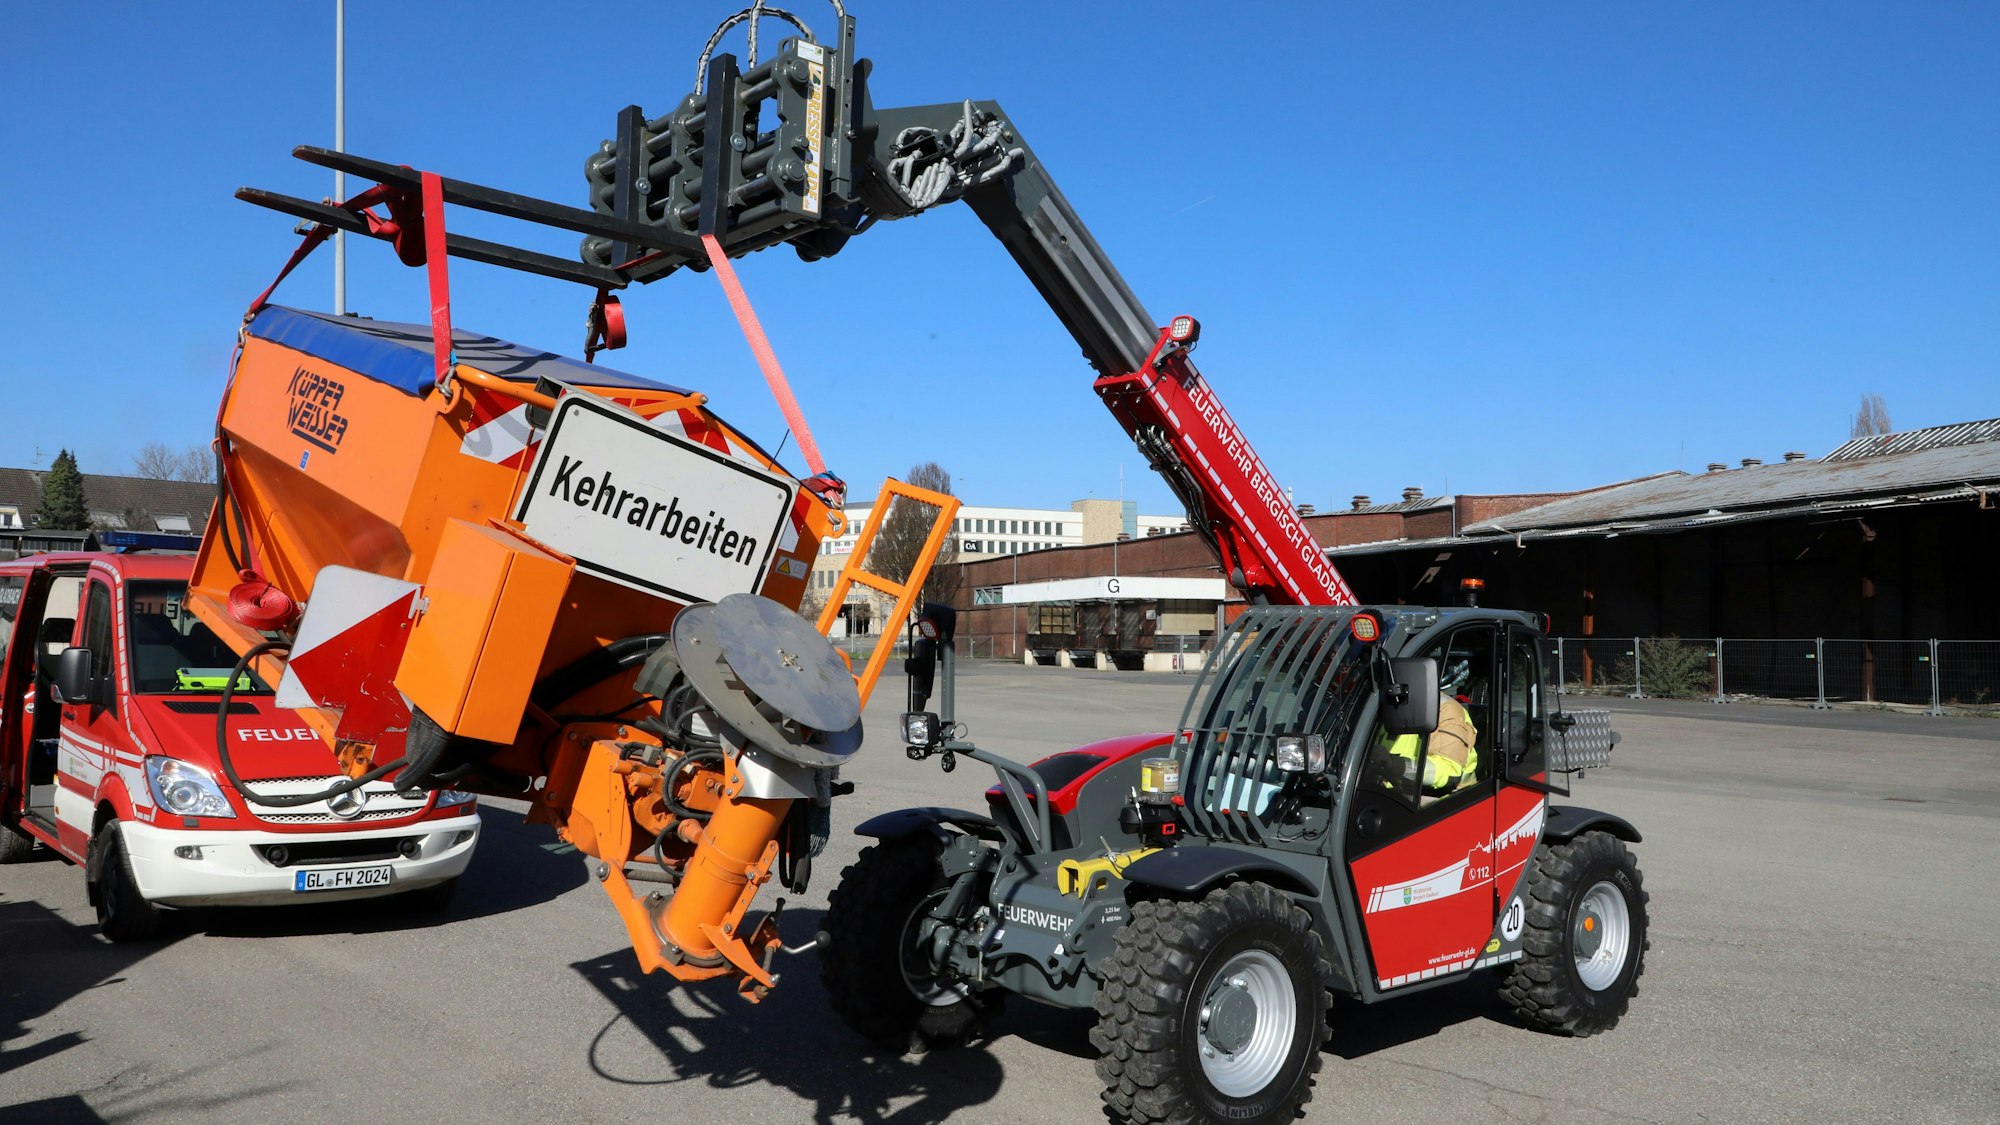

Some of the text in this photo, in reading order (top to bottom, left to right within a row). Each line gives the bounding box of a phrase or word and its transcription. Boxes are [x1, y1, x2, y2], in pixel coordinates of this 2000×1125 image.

[1183, 376, 1349, 606] FEUERWEHR BERGISCH GLADBA
[549, 455, 757, 566] Kehrarbeiten
[1107, 578, 1120, 593] G
[307, 868, 389, 888] GL FW 2024
[1477, 866, 1490, 879] 112
[1506, 903, 1519, 932] 20
